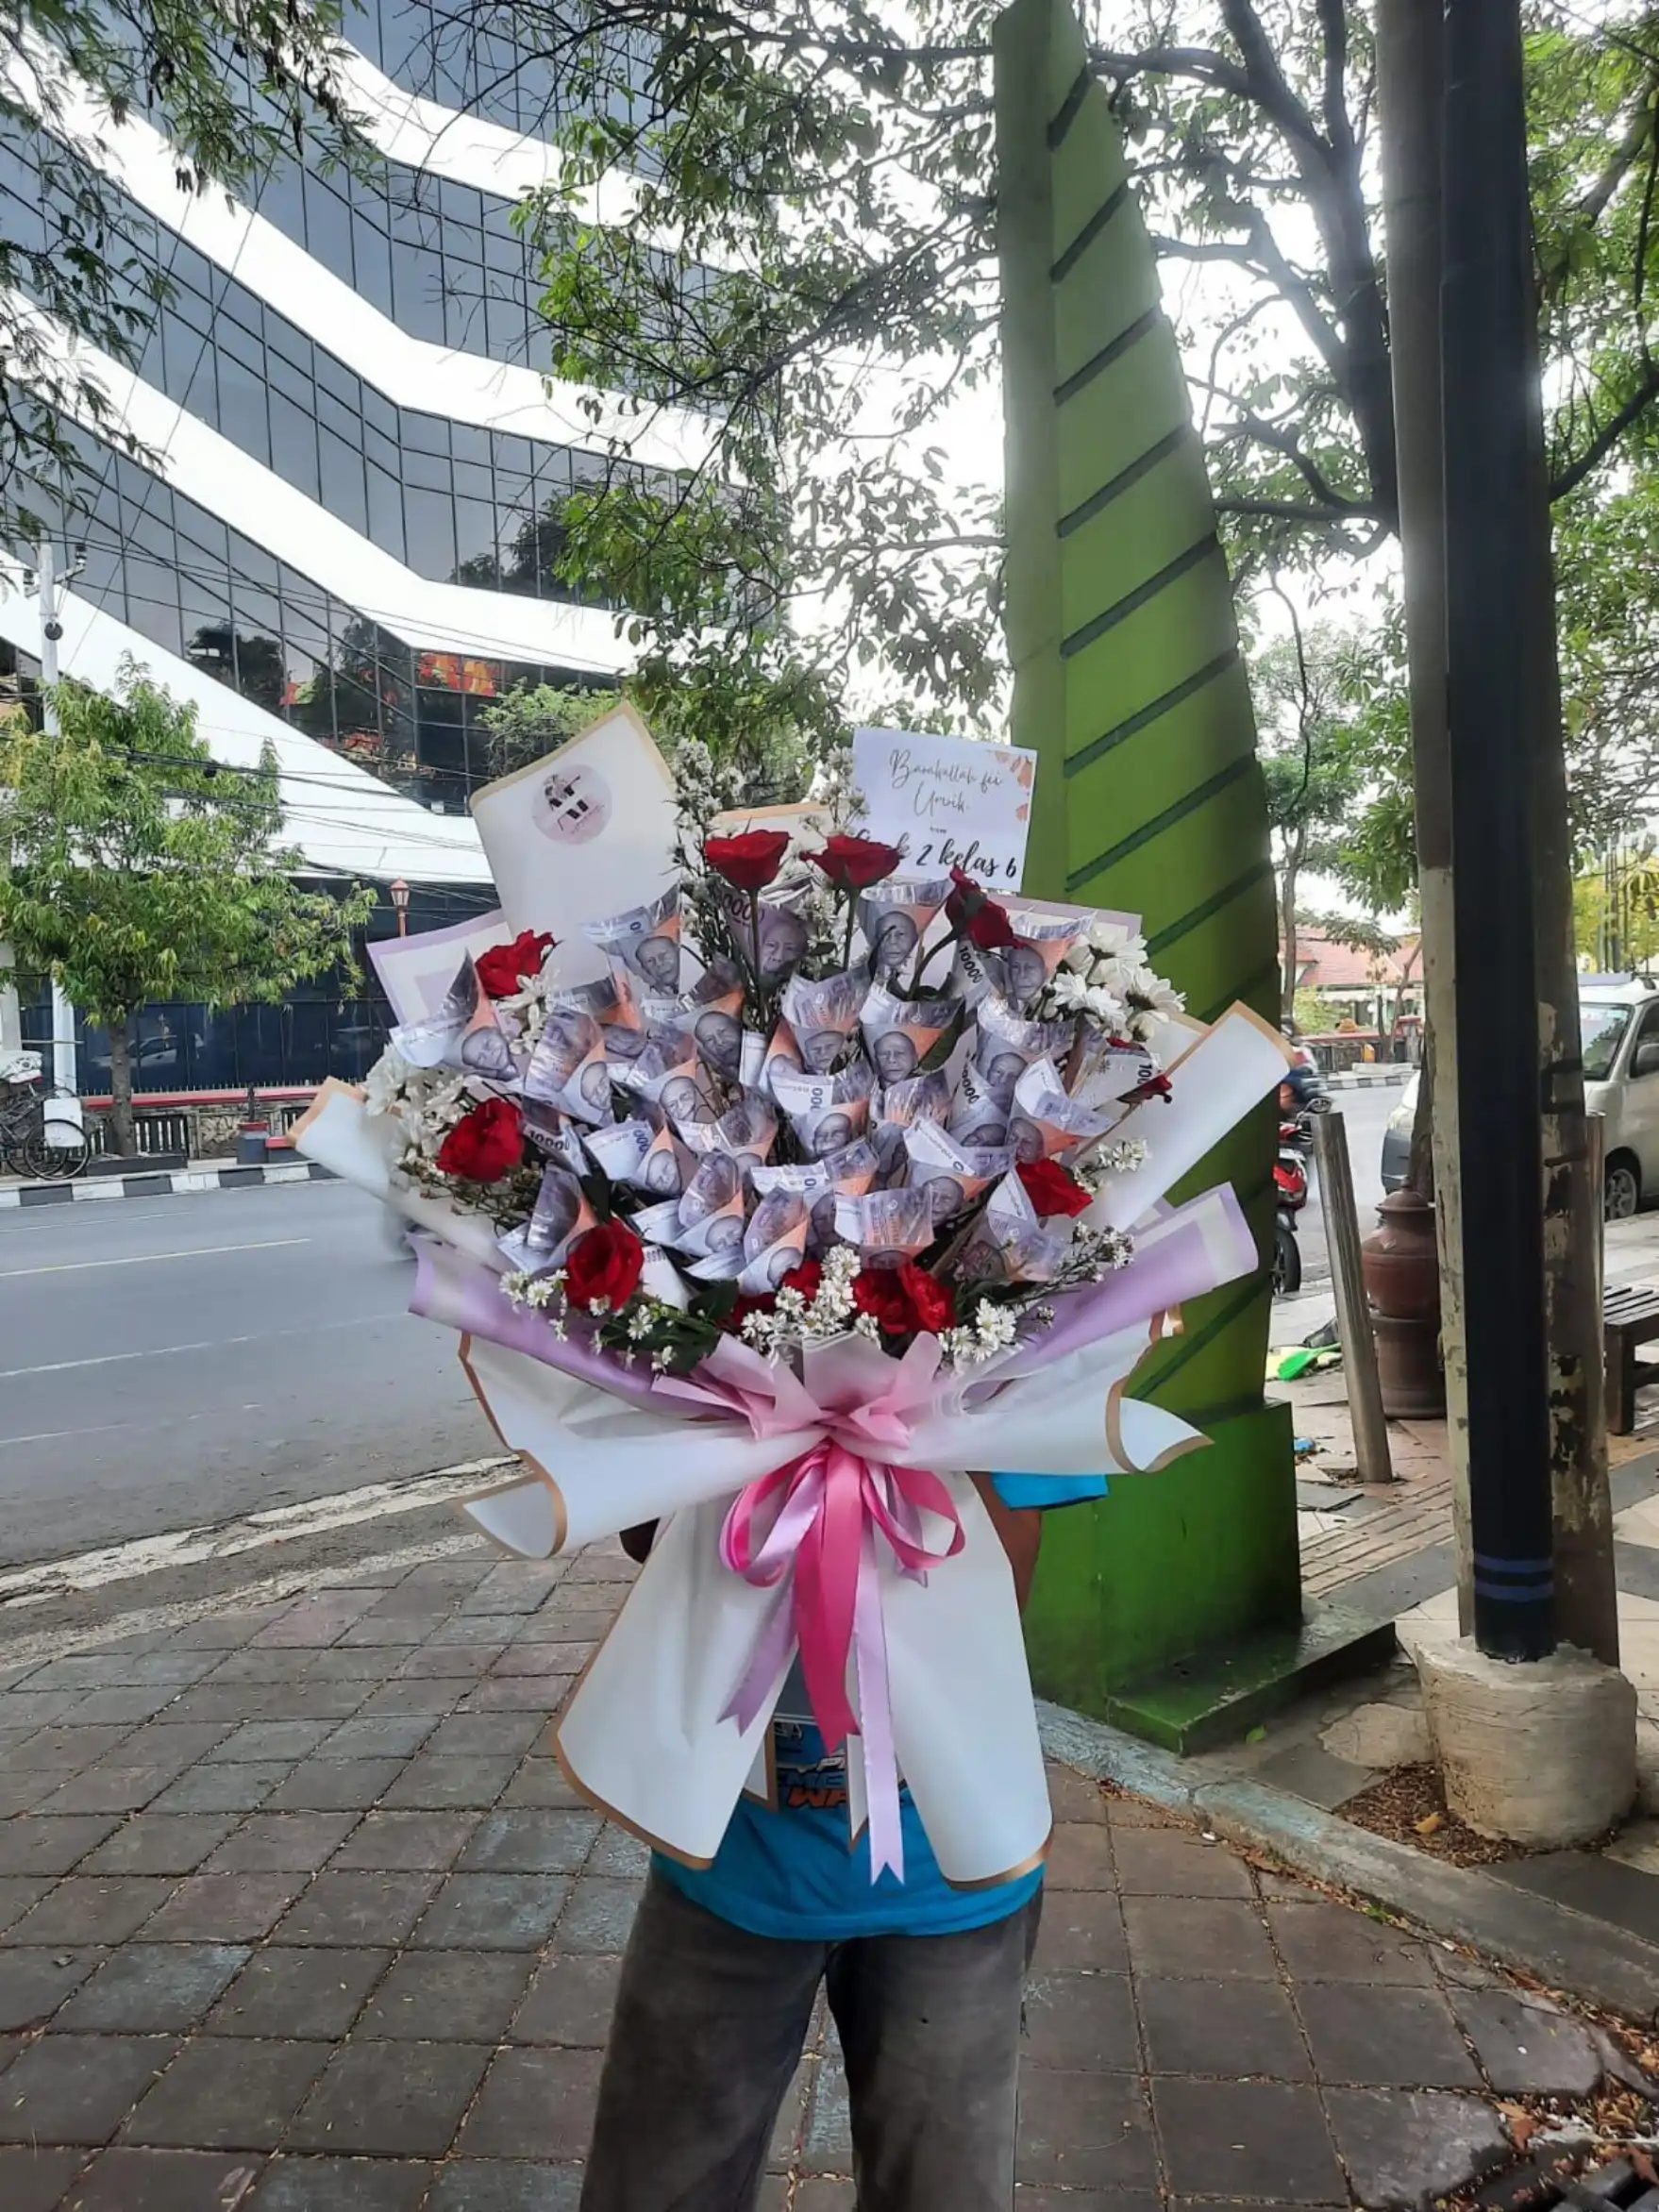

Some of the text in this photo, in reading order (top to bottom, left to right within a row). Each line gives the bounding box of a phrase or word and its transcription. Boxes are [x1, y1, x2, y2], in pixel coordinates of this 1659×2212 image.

[938, 837, 999, 878] kelas
[1005, 857, 1017, 879] 6
[959, 945, 983, 983] 10000
